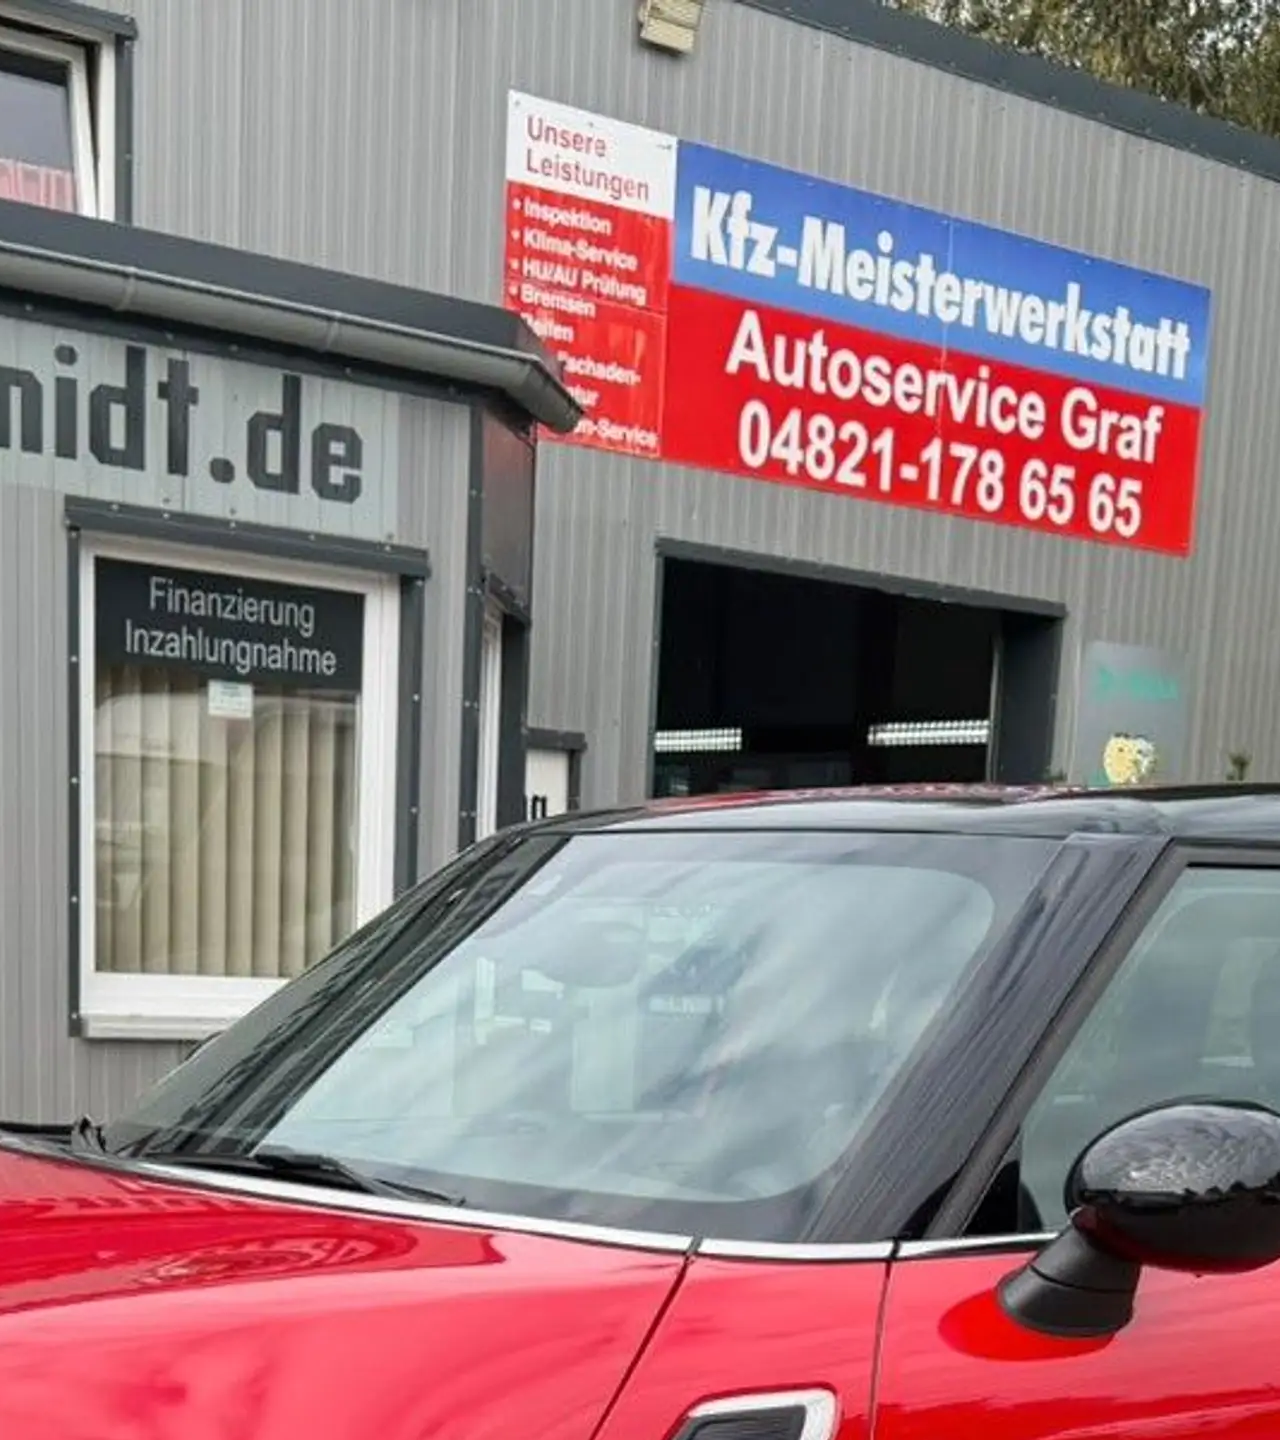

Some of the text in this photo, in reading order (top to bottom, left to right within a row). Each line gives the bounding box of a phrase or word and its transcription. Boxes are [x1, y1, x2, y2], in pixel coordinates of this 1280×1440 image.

[527, 114, 607, 158] Unsere
[526, 148, 649, 201] Leistungen
[523, 196, 612, 236] Inspektion
[523, 227, 639, 272] Klima-Service
[520, 283, 597, 319] Bremsen
[522, 256, 647, 307] HU/AU Prüfung
[690, 185, 1192, 380] Kfz-Meisterwerkstatt
[725, 309, 1165, 464] Autoservice Graf
[738, 400, 1143, 538] 04821-178 65 65
[149, 576, 316, 639] Finanzierung
[125, 619, 338, 676] Inzahlungnahme
